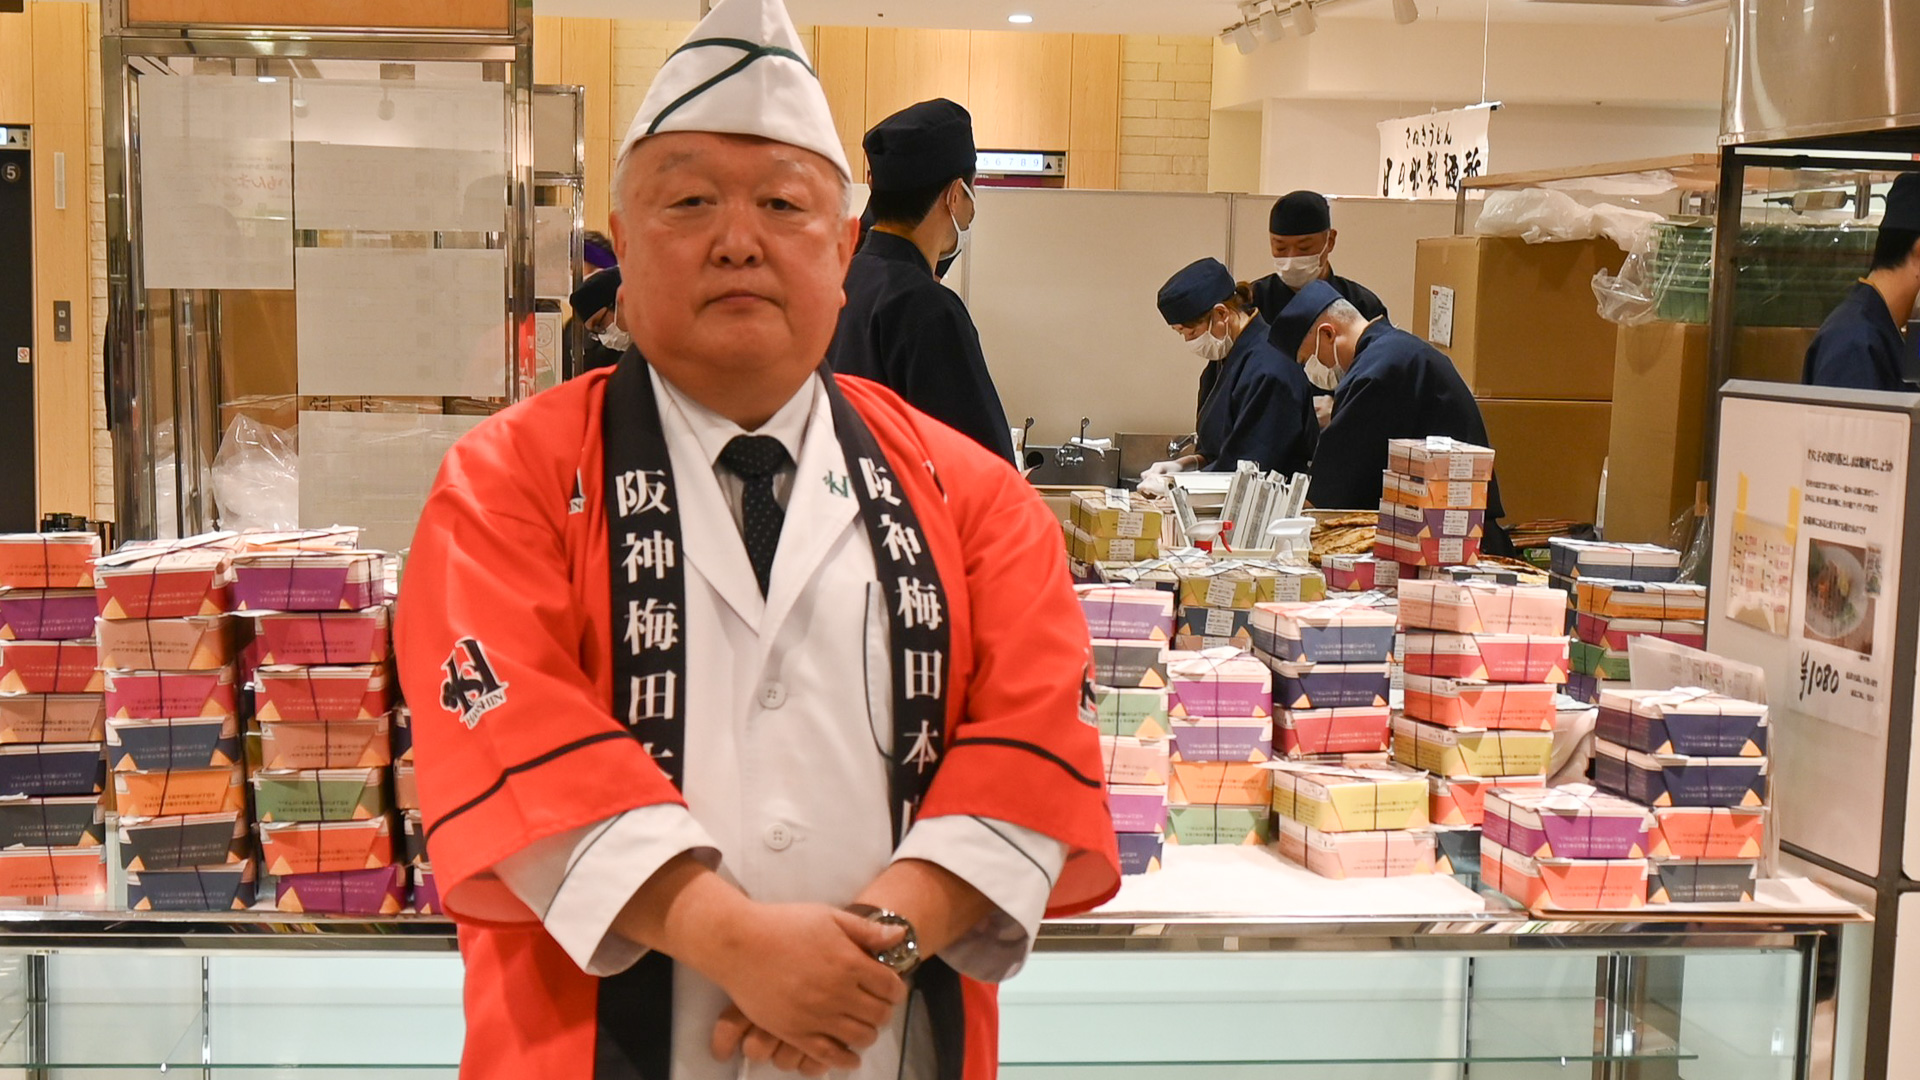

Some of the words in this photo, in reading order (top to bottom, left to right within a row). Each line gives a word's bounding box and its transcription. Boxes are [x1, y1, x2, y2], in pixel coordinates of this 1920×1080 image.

[1405, 121, 1453, 149] さぬきうどん
[6, 165, 16, 179] 5
[1799, 651, 1840, 702] ¥1080
